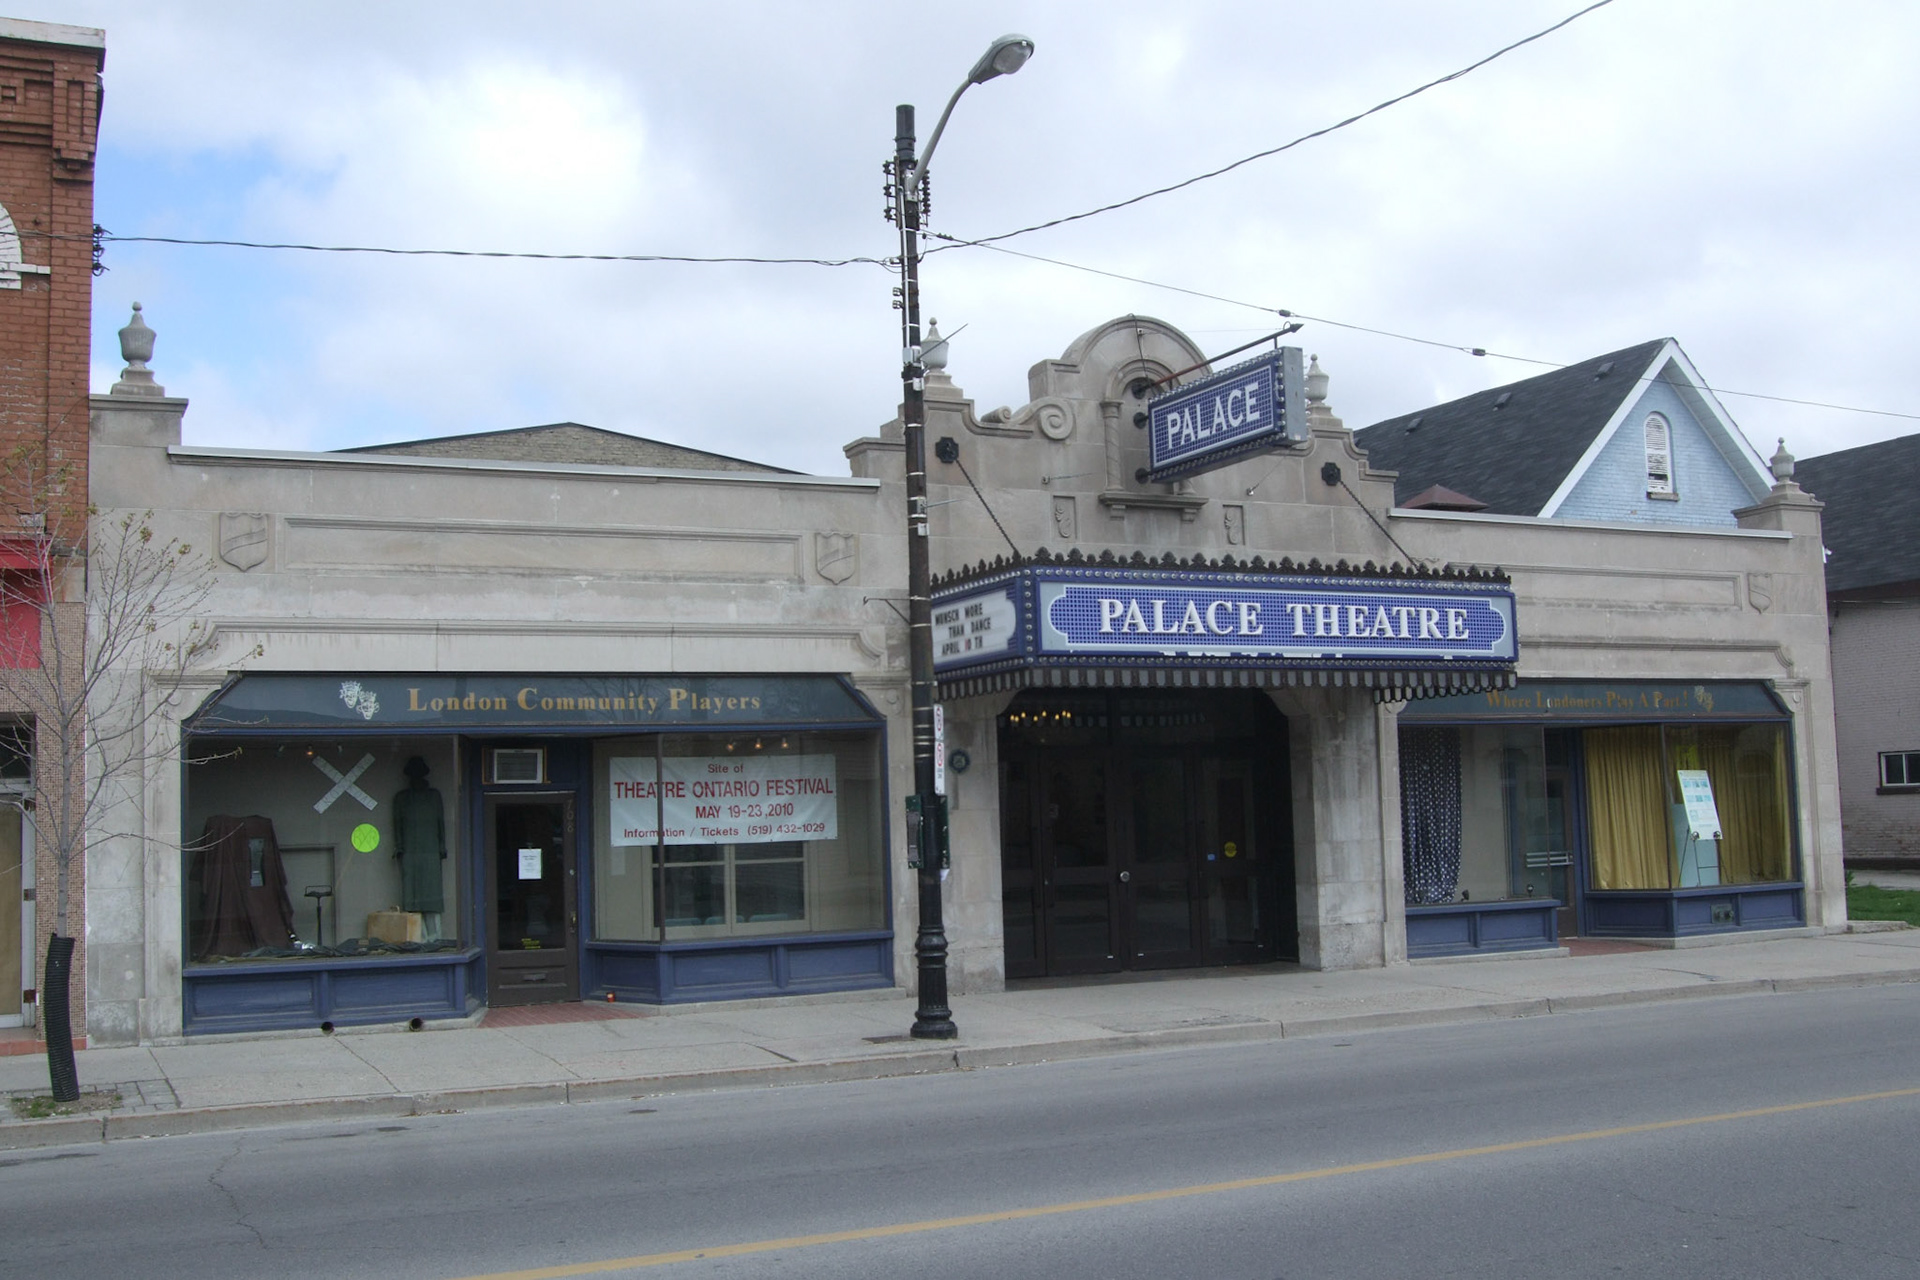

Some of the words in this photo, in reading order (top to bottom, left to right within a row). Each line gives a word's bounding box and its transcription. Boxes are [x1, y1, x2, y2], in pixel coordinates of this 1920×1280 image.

[1166, 381, 1260, 449] PALACE
[965, 602, 983, 619] MORE
[1099, 598, 1264, 635] PALACE
[1286, 603, 1470, 640] THEATRE
[949, 624, 965, 639] THAN
[971, 616, 991, 633] DANCE
[942, 641, 960, 656] APRIL
[407, 687, 508, 711] London
[517, 687, 658, 714] Community
[667, 688, 761, 714] Players
[1485, 688, 1532, 708] Where
[1640, 690, 1649, 708] A
[707, 763, 729, 774] Site
[733, 763, 744, 773] of
[692, 779, 760, 798] ONTARIO
[766, 778, 834, 796] FESTIVAL
[695, 805, 721, 819] MAY
[701, 827, 739, 837] Tickets
[747, 824, 772, 837] (519)
[776, 822, 825, 834] 432-1029
